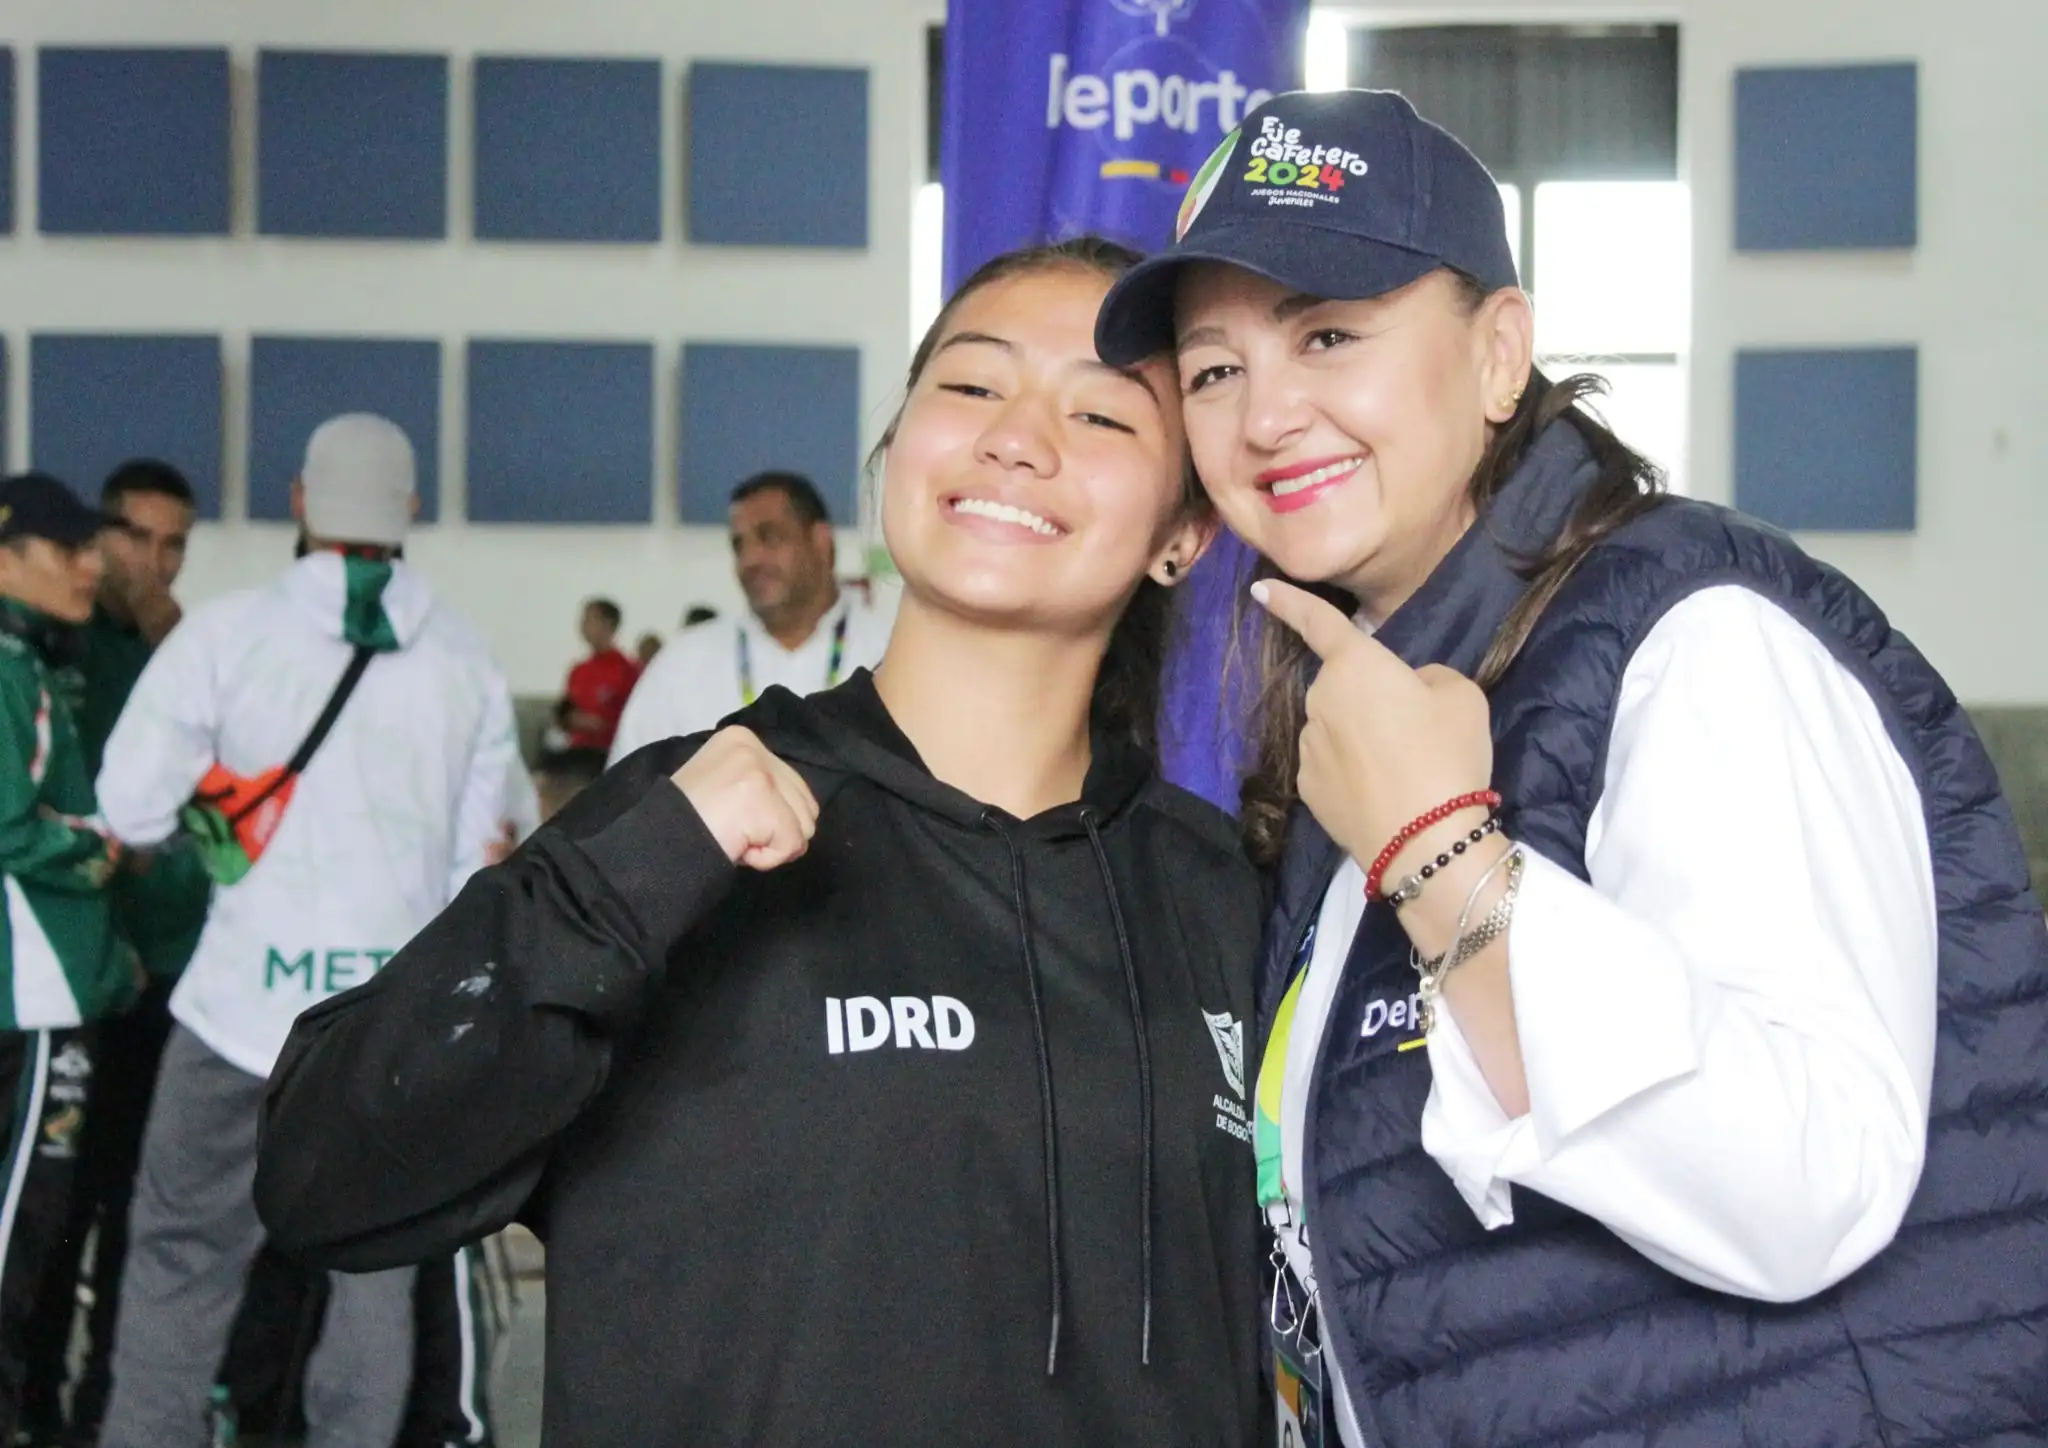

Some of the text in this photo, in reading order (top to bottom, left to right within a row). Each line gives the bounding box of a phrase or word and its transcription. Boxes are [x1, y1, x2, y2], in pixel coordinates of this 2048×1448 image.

[1261, 116, 1301, 145] Eje
[1243, 157, 1345, 191] 2024
[1250, 188, 1340, 204] JUEGOS NACIONALES
[264, 946, 396, 992] MET
[825, 995, 976, 1055] IDRD
[1216, 1113, 1227, 1130] DE
[1227, 1119, 1251, 1144] BOGO
